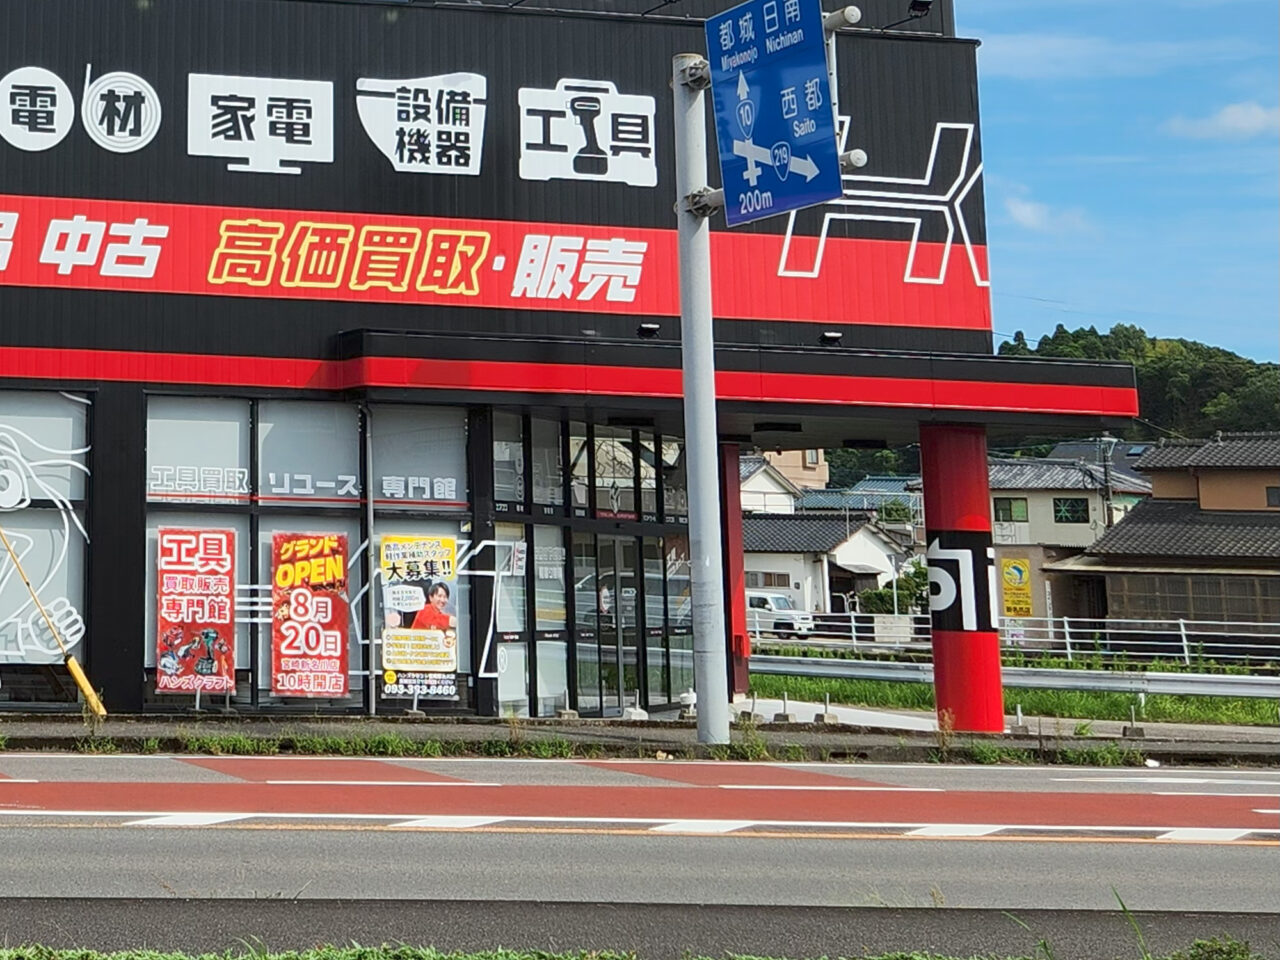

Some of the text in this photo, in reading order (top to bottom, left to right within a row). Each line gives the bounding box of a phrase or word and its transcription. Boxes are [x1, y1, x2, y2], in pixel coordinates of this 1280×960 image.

[719, 11, 756, 51] 都城
[765, 28, 804, 55] Nichinan
[394, 85, 473, 127] 設備
[780, 77, 823, 120] 西都
[210, 94, 313, 145] 家電
[739, 105, 752, 127] 10
[792, 118, 817, 139] Saito
[394, 127, 471, 168] 機器
[525, 108, 652, 159] 工具
[773, 146, 789, 167] 219
[739, 189, 773, 214] 200m
[39, 215, 170, 279] 中古
[150, 465, 250, 493] 工具買取
[268, 472, 360, 496] リユース
[382, 476, 457, 499] 専門館
[161, 533, 231, 573] 工具
[280, 535, 339, 561] グランド
[163, 575, 230, 595] 買取販売
[275, 555, 344, 589] OPEN
[161, 595, 231, 624] 専門館
[290, 588, 332, 623] 8月
[280, 621, 342, 657] 20日
[159, 675, 234, 690] ハンズクラフト
